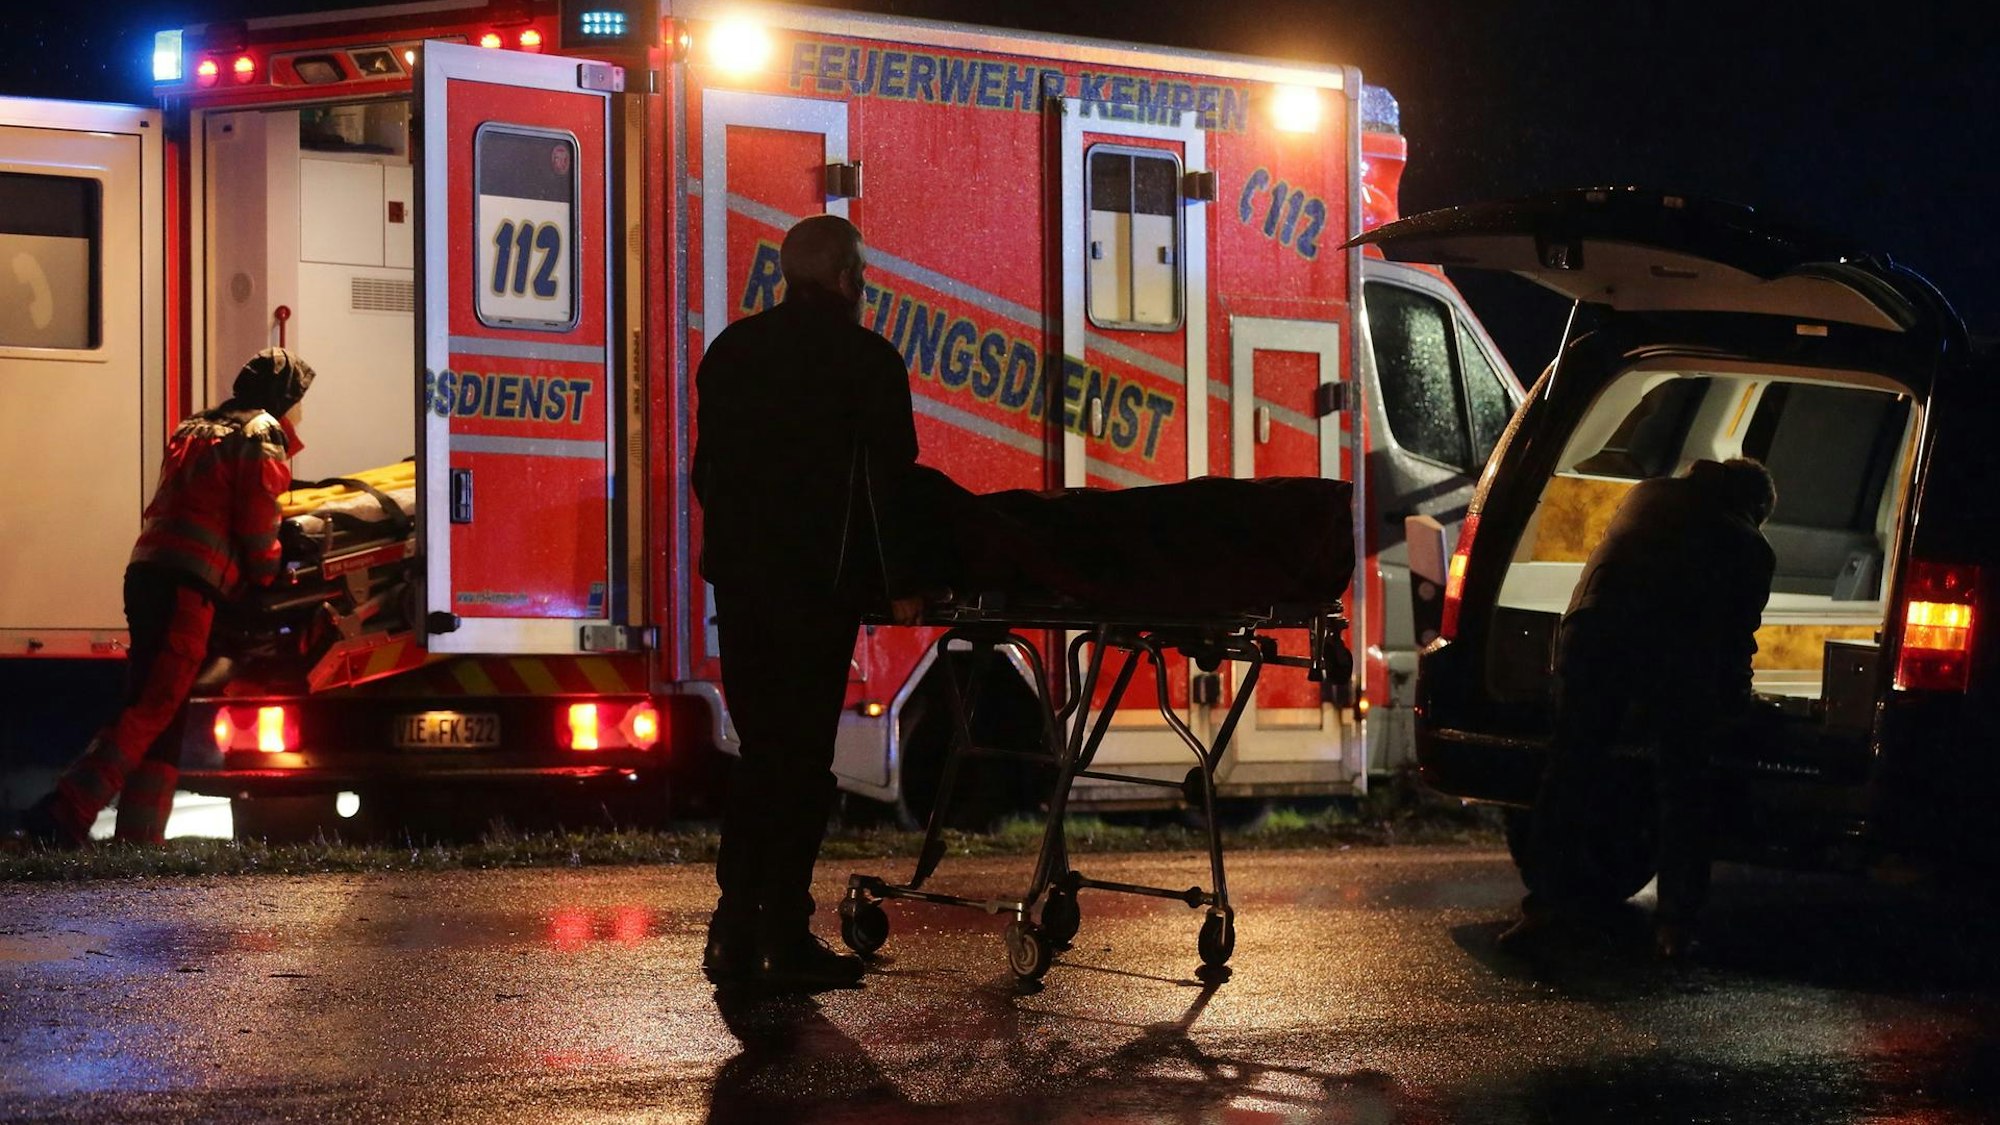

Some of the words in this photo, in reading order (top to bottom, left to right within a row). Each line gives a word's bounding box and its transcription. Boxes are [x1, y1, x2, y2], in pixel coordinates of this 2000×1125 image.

[790, 41, 1066, 116] FEUERWEHR
[1078, 71, 1249, 133] KEMPEN
[492, 218, 561, 298] 112
[1262, 179, 1327, 262] 112
[740, 238, 1176, 460] RUNGSDIENST
[396, 718, 426, 743] VIE
[438, 718, 462, 743] FK
[464, 717, 494, 743] 522
